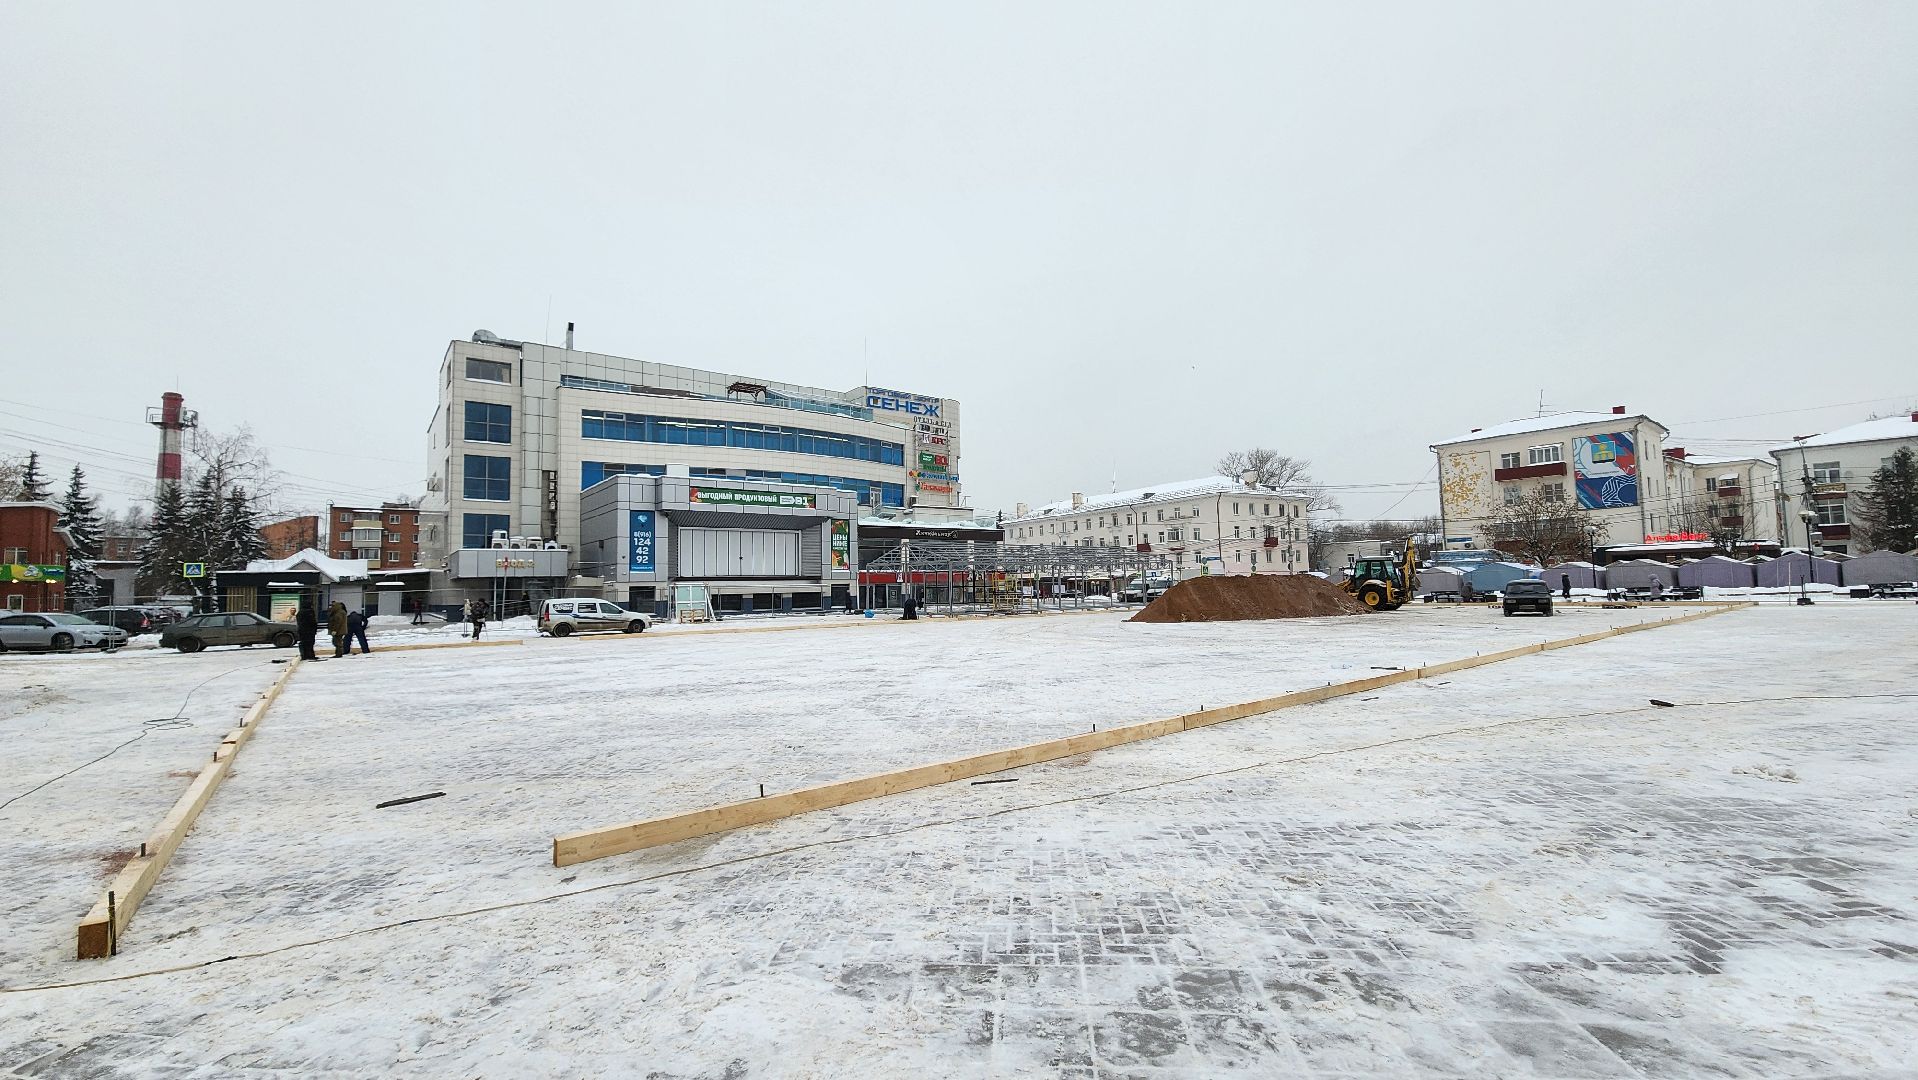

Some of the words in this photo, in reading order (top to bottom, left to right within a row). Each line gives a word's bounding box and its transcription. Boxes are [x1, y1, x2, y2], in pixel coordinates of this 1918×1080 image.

[866, 396, 940, 418] СЕНЕЖ
[697, 491, 733, 501] ВЫГОДНЫЙ
[734, 493, 777, 503] ПРОДУКТОВЫЙ
[634, 538, 651, 546] 124
[636, 547, 649, 555] 42
[636, 555, 649, 564] 92
